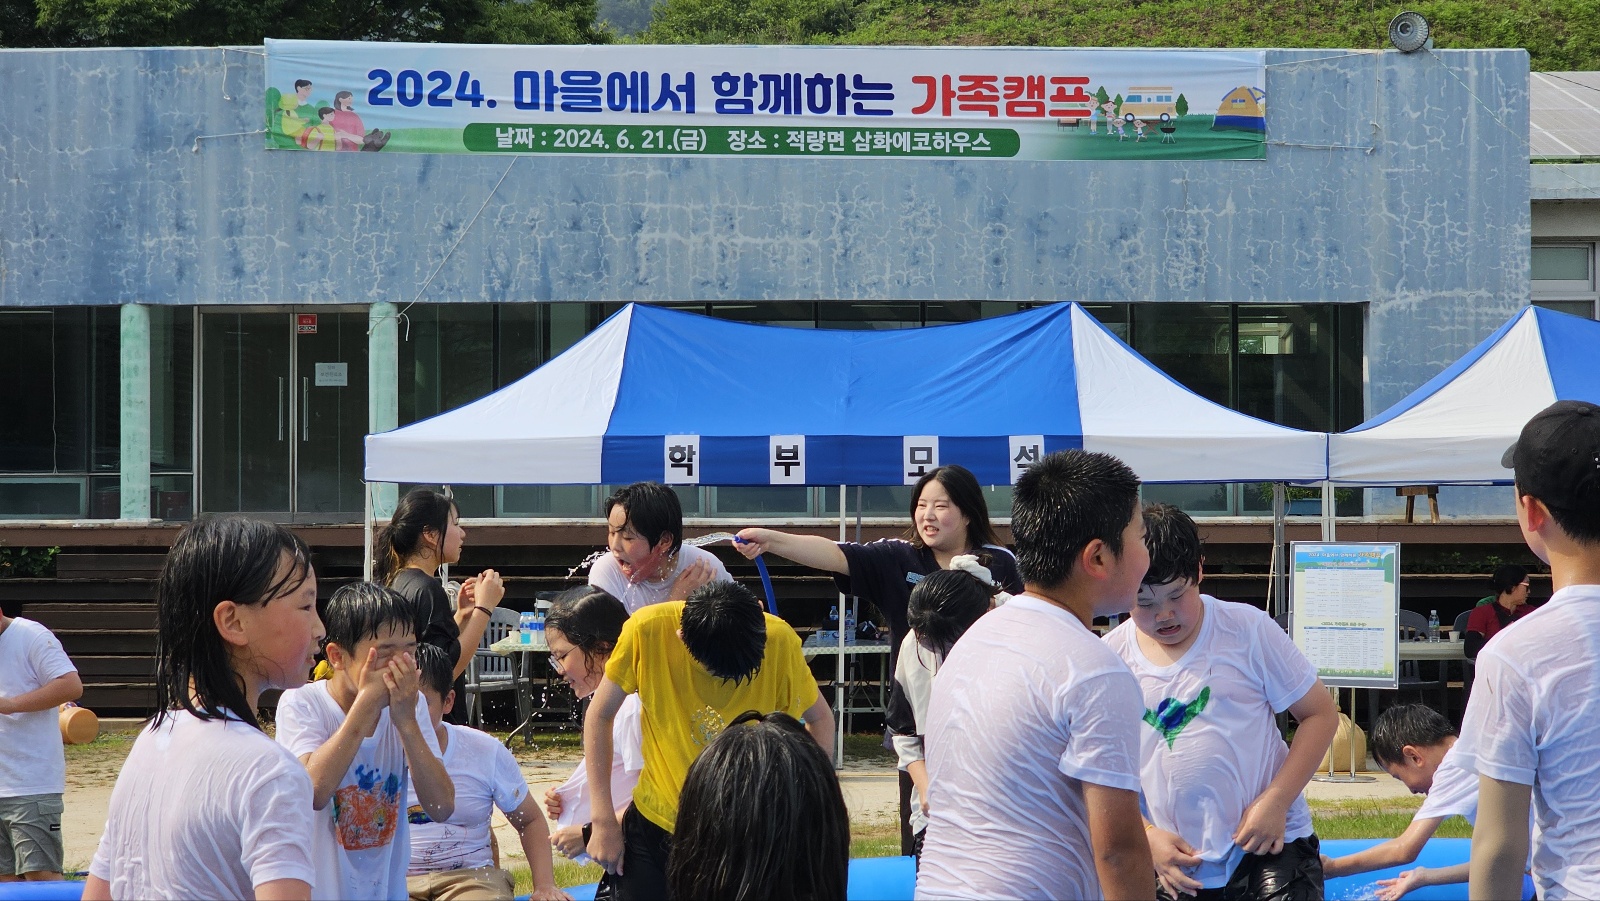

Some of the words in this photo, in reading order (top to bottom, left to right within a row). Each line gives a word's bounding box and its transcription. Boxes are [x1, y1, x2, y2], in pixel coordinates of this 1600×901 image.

[367, 69, 498, 109] 2024.
[513, 69, 697, 114] 마을에서
[711, 71, 896, 116] 함께하는
[911, 74, 1091, 117] 가족캠프
[495, 127, 535, 149] 날짜
[553, 128, 610, 149] 2024.
[616, 128, 635, 150] 6.
[641, 129, 708, 152] 21.(금)
[726, 129, 767, 152] 장소
[785, 130, 845, 152] 적량면
[851, 130, 992, 153] 삼화에코하우스
